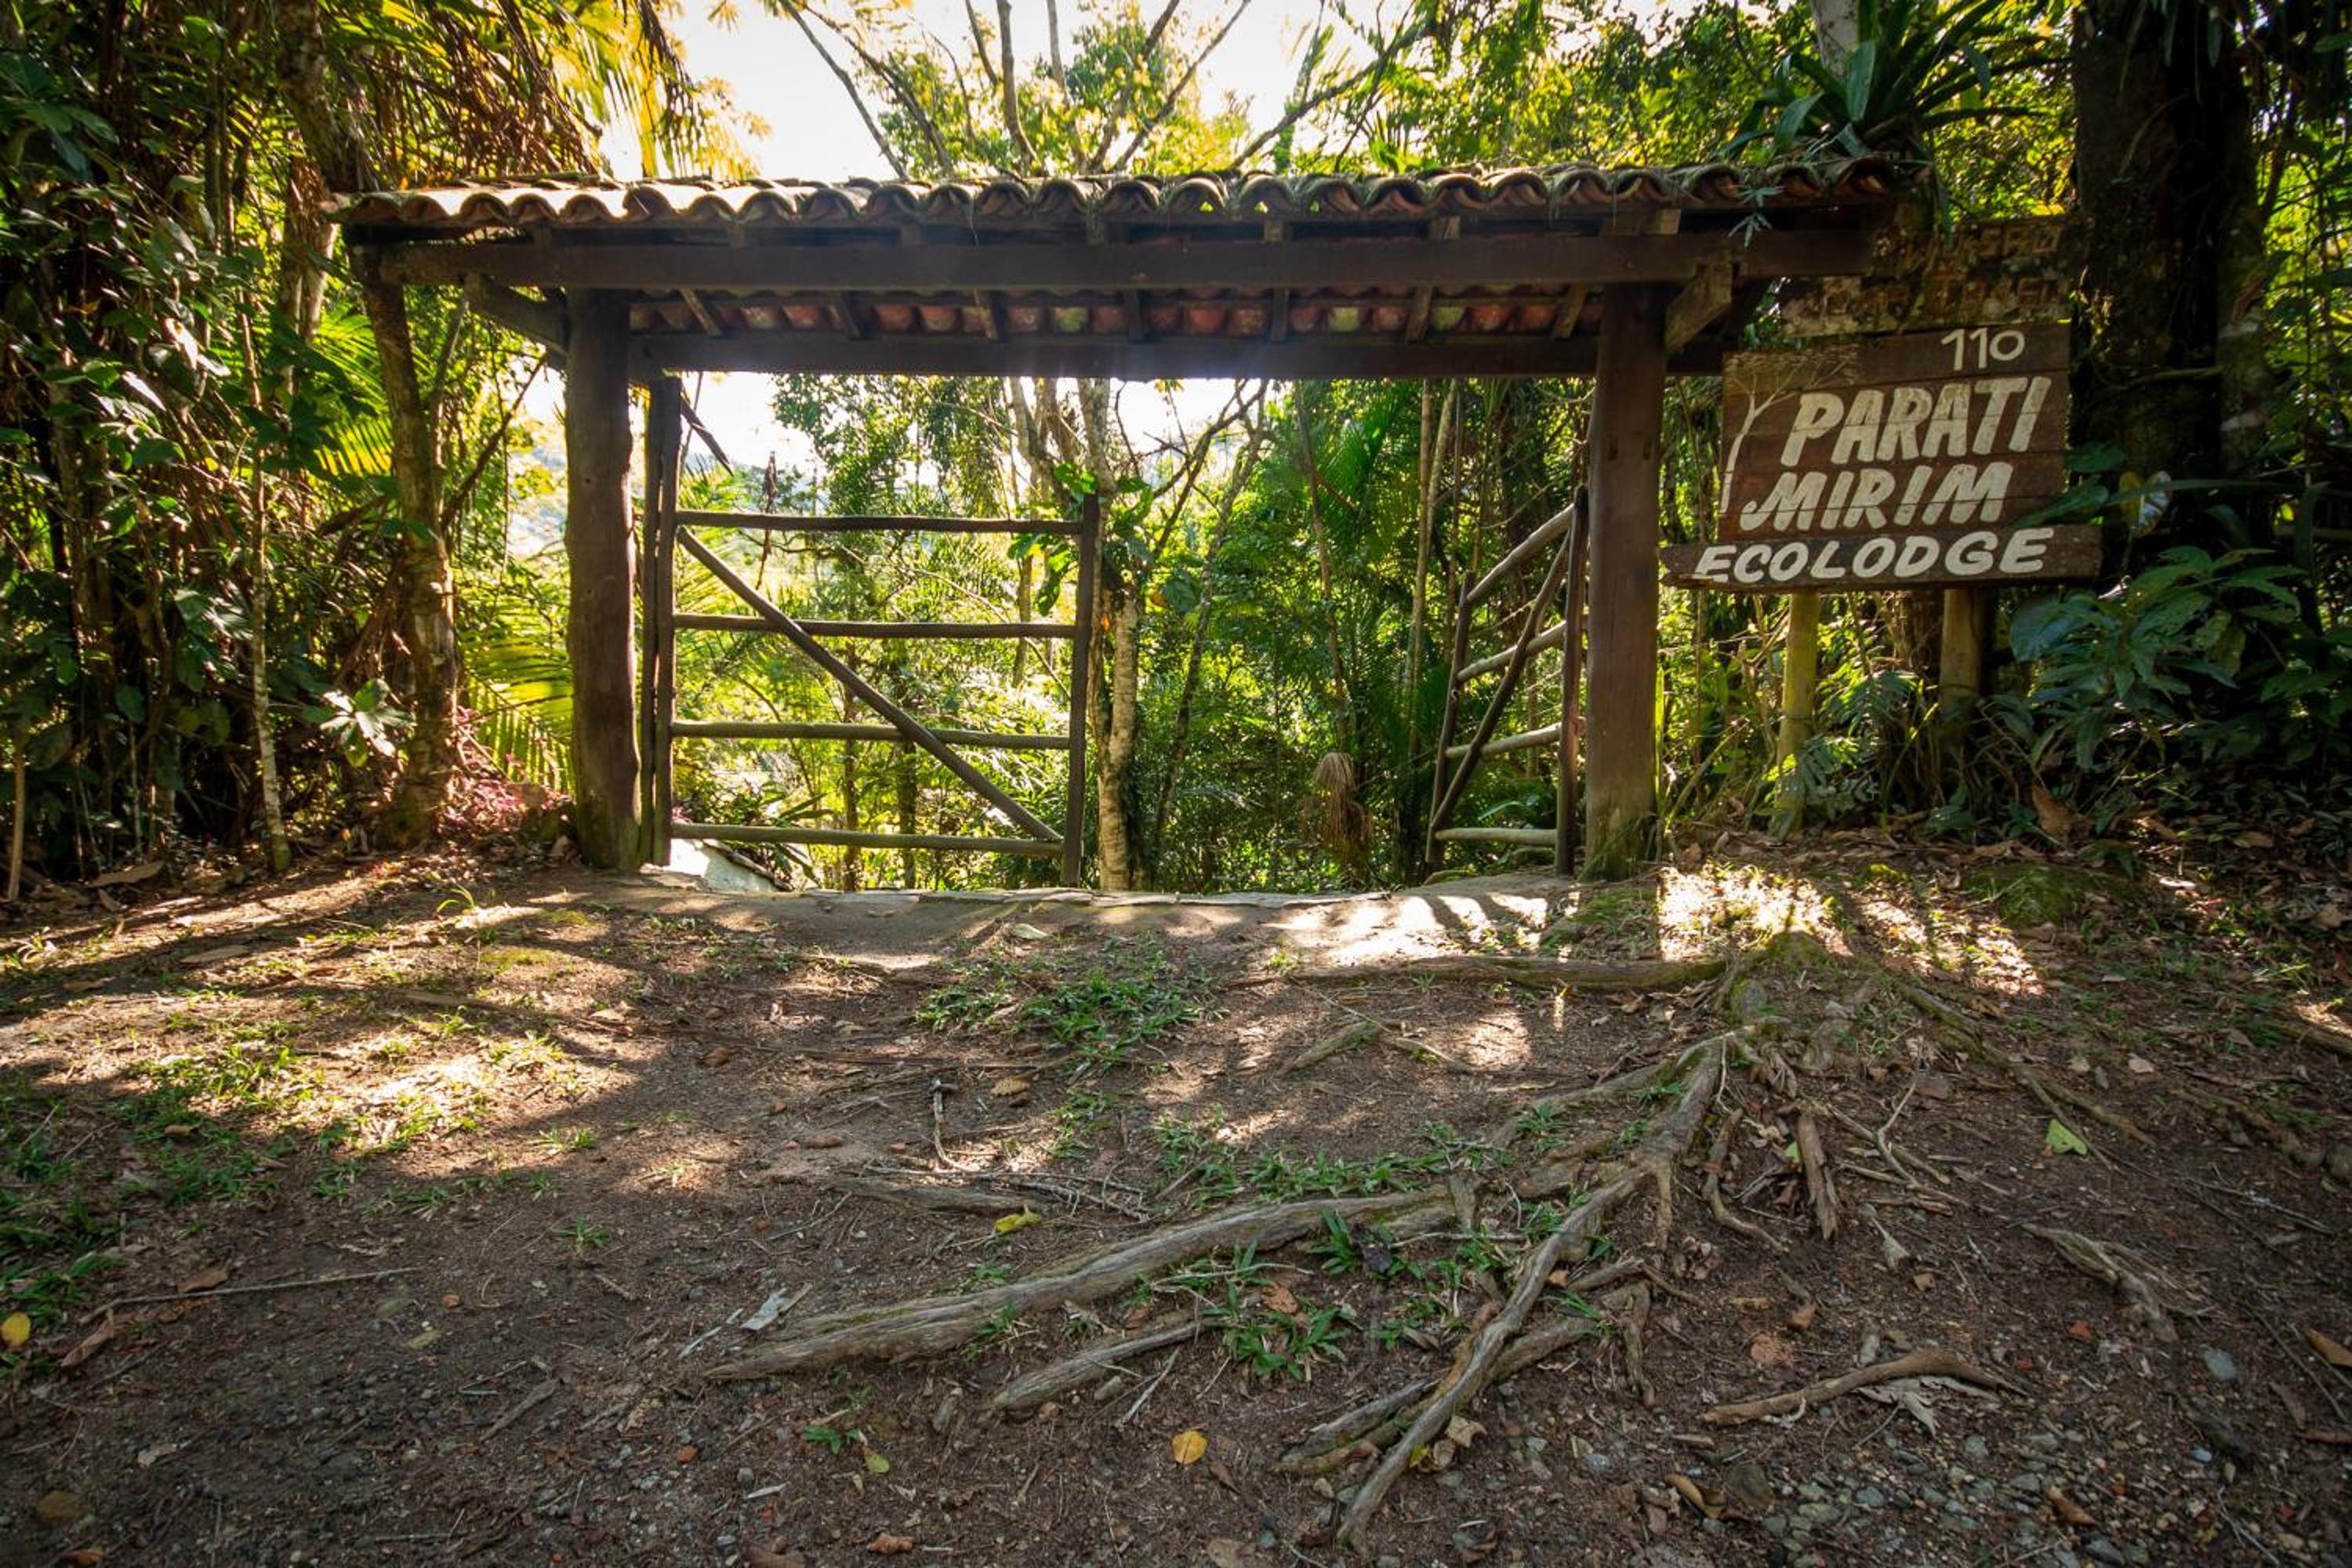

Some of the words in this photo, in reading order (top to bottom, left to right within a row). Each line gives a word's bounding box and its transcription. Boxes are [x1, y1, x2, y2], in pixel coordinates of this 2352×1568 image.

[1941, 328, 2025, 371] 110
[1780, 376, 2052, 467] PARATI
[1739, 461, 2013, 532] MIRIM
[1692, 528, 2055, 583] ECOLODGE
